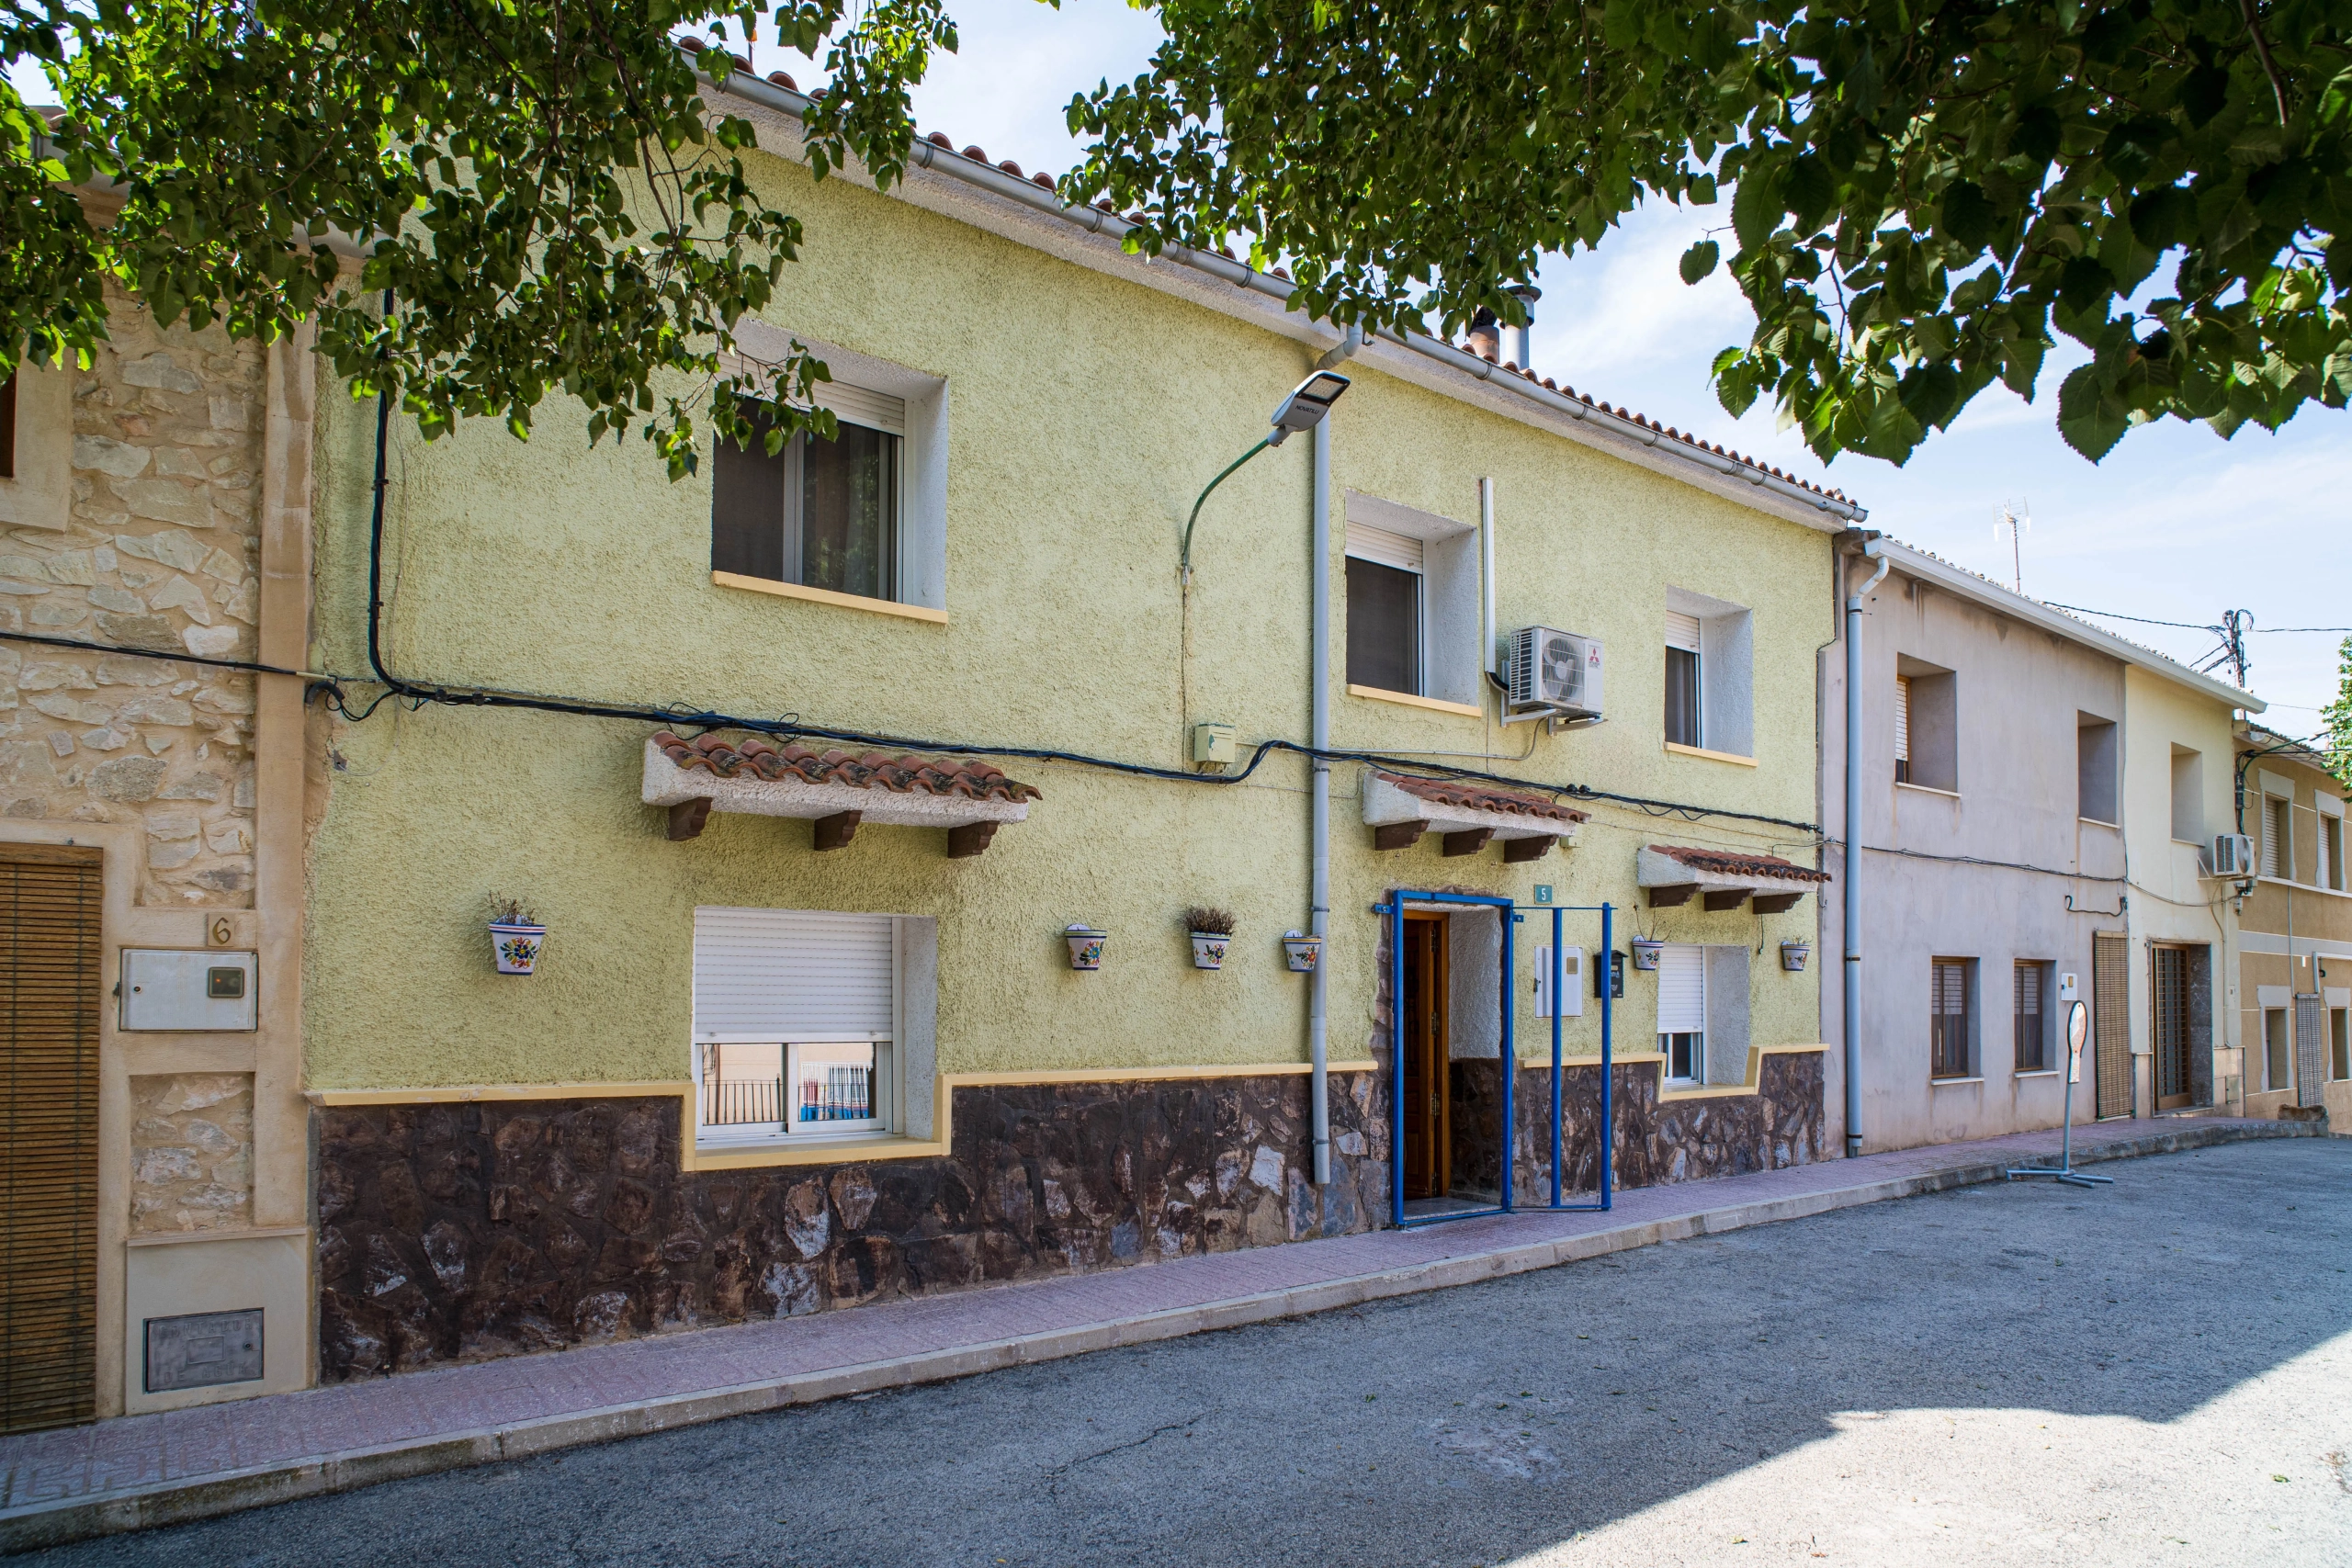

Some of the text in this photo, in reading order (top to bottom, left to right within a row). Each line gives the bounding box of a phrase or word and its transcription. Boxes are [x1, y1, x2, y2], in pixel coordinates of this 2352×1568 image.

[1295, 404, 1320, 414] NOVATILU
[1541, 887, 1546, 901] 5
[212, 917, 232, 945] 6
[159, 1318, 253, 1337] CONTADOR
[164, 1362, 246, 1383] DE AGUA
